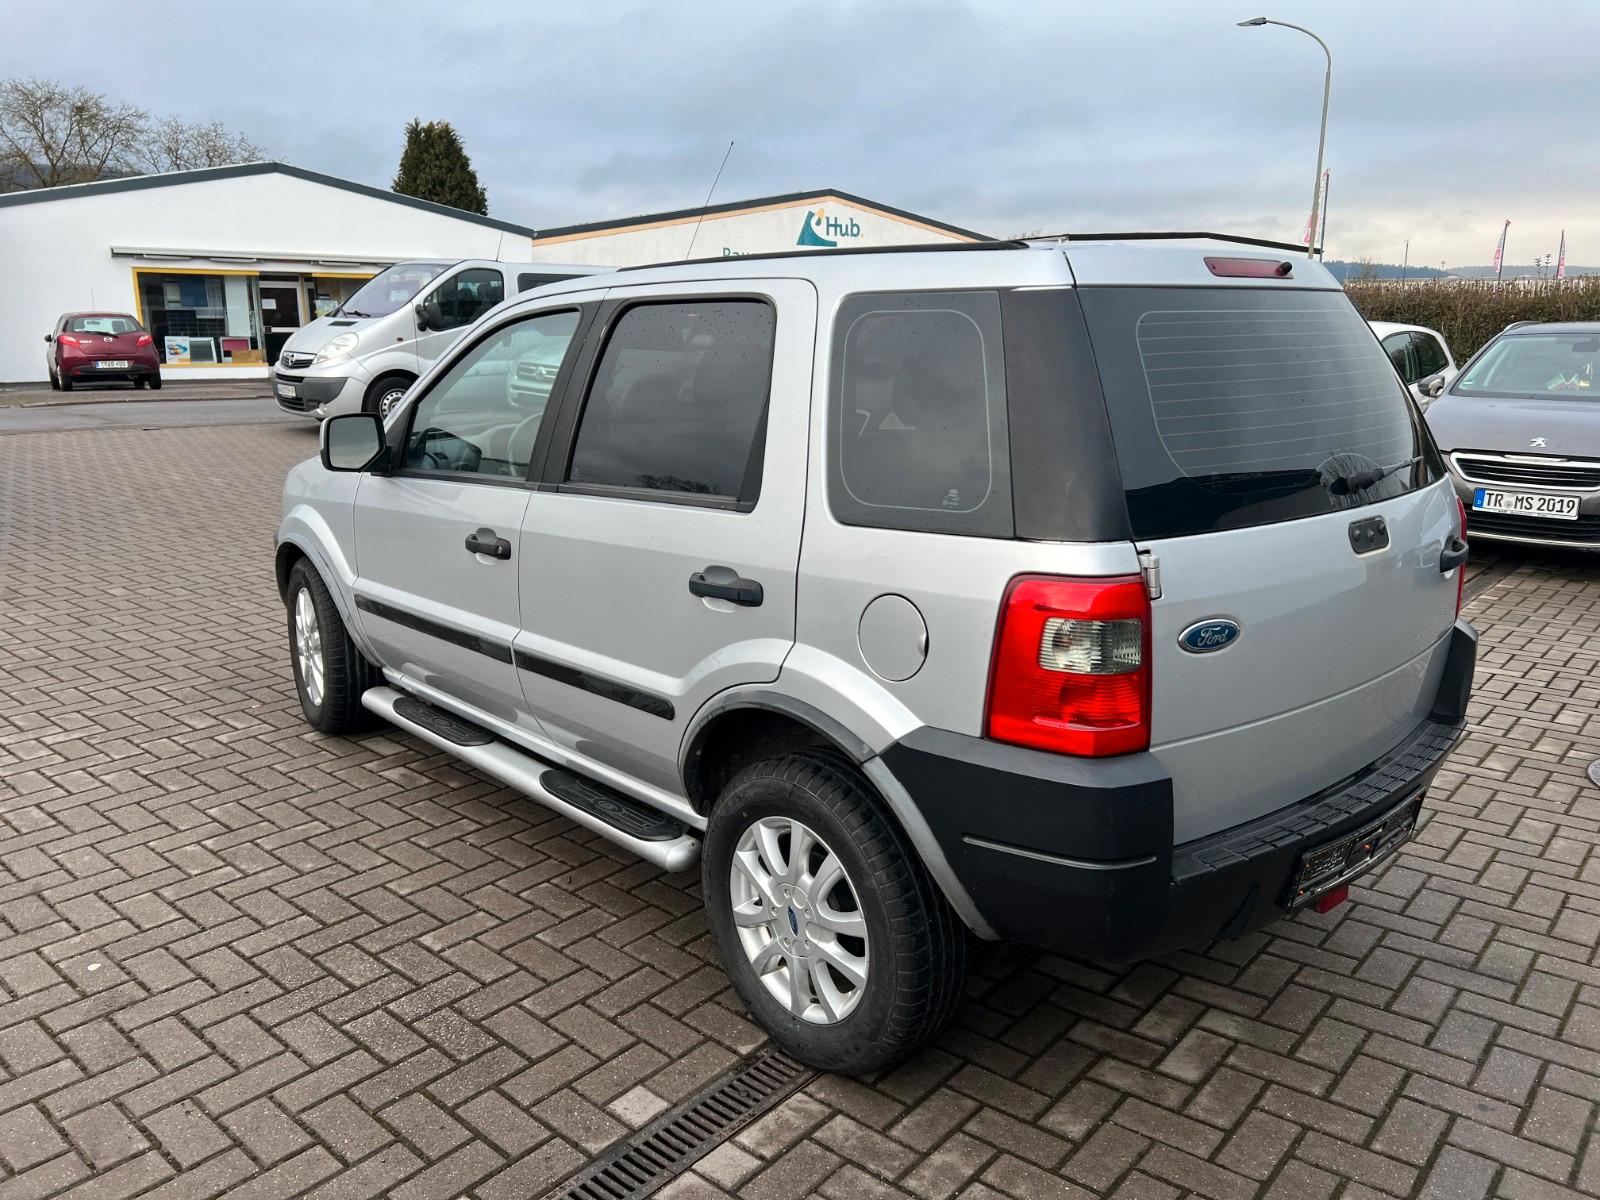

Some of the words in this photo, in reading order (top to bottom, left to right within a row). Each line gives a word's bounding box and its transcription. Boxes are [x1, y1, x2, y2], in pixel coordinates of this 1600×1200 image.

[1486, 492, 1504, 507] TR
[1514, 495, 1534, 511] MS
[1536, 497, 1576, 514] 2019
[1197, 626, 1229, 647] Ford
